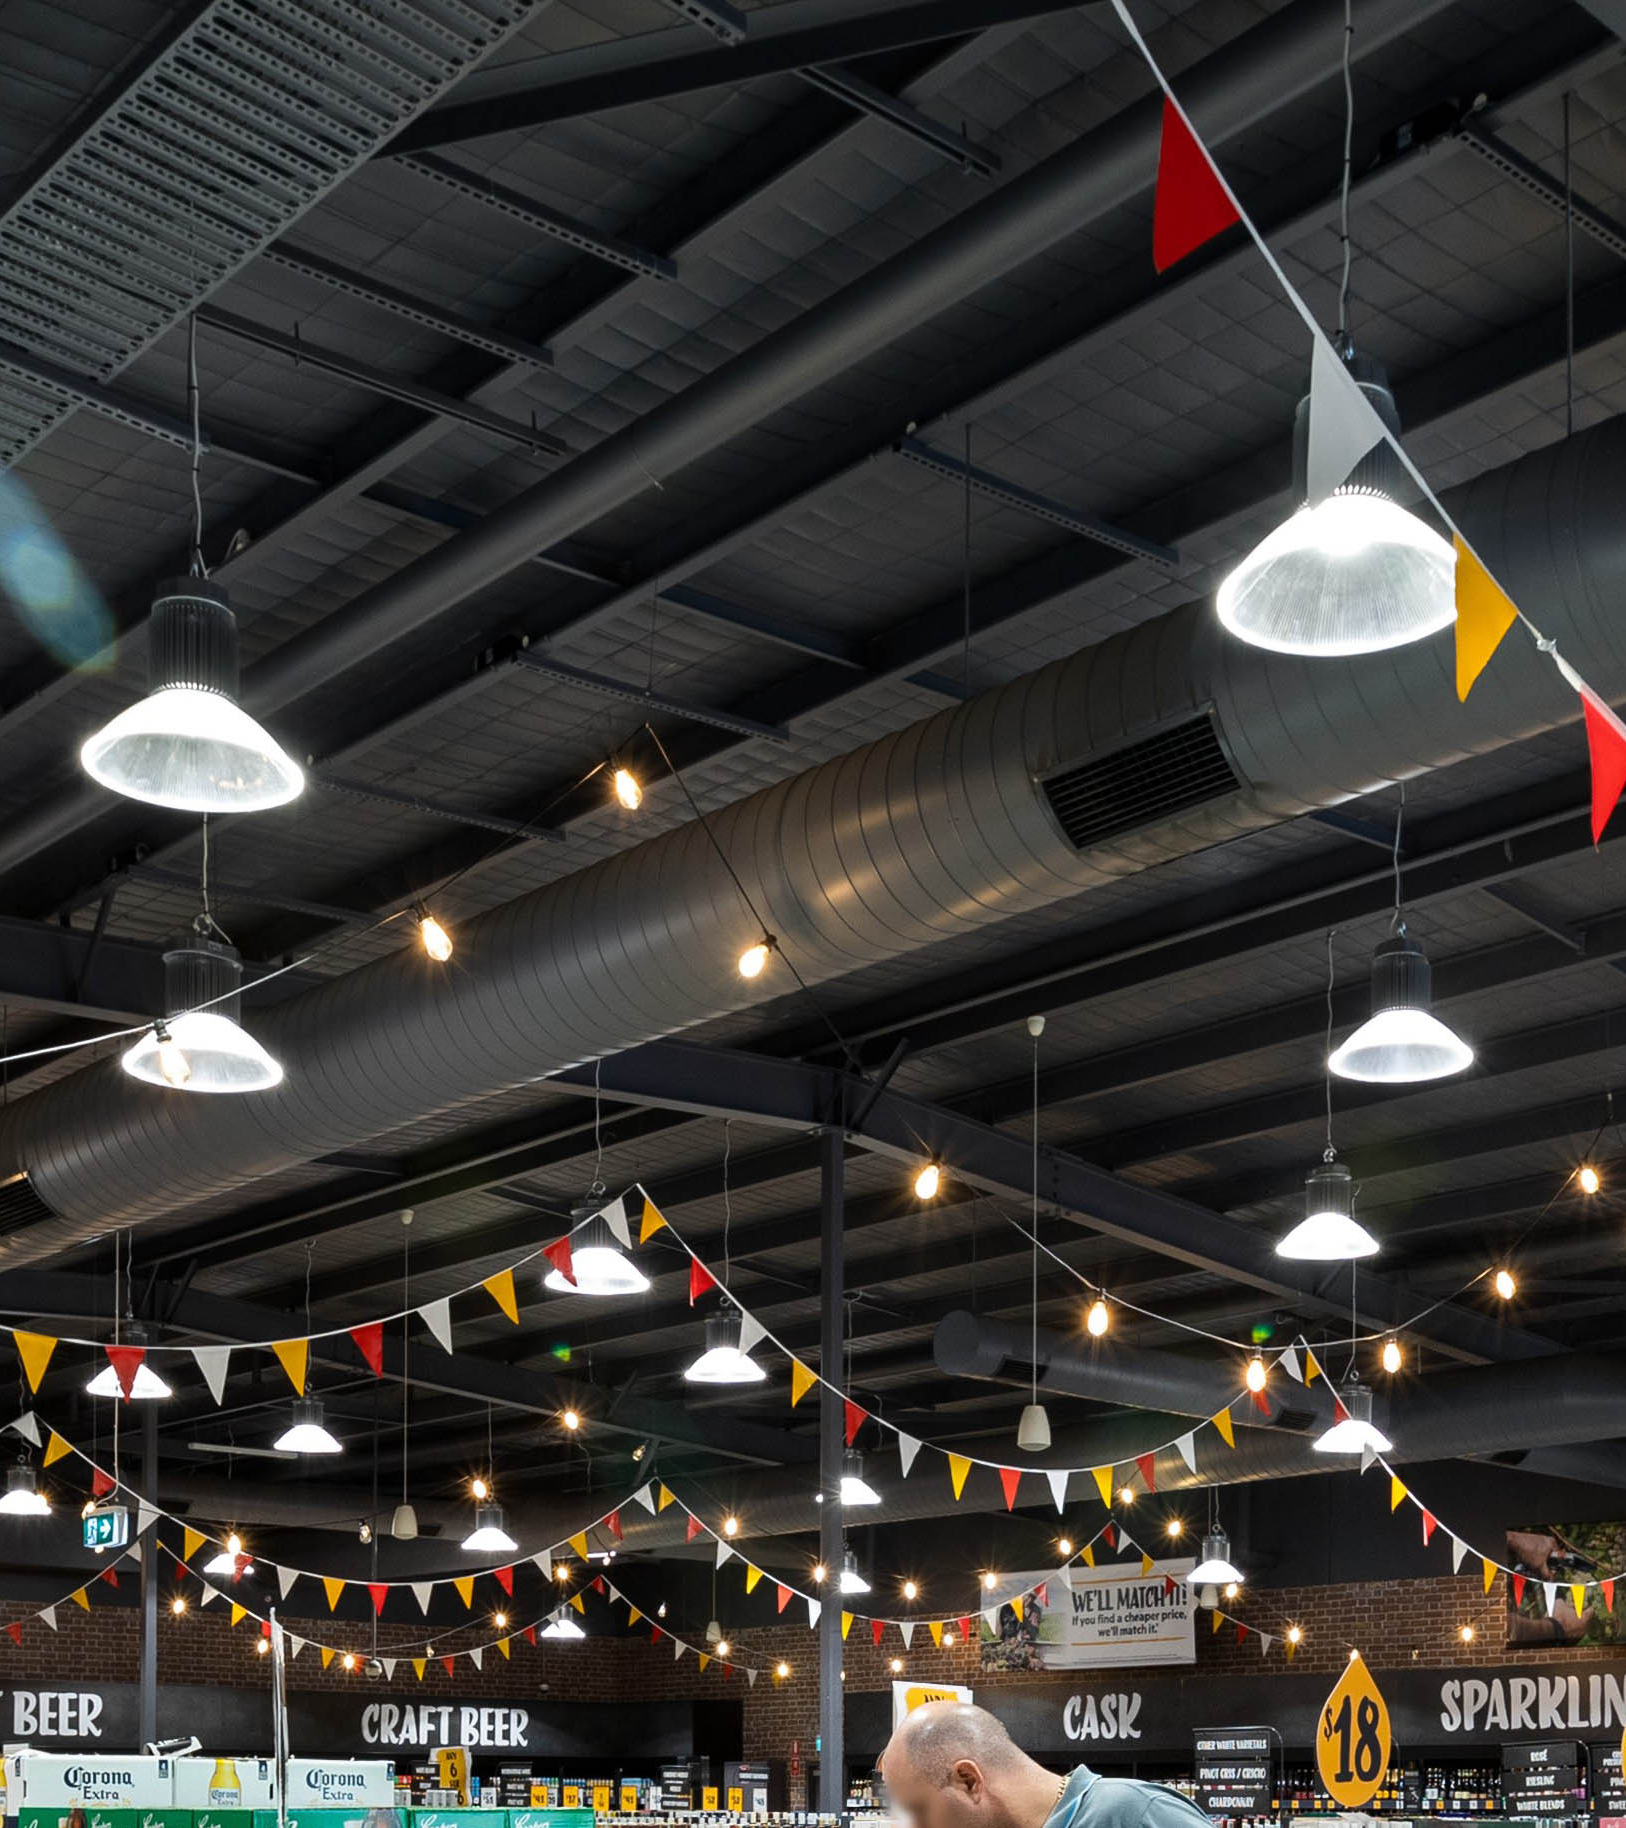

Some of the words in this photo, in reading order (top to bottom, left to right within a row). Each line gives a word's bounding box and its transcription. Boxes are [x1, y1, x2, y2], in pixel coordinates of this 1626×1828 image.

[1072, 1589, 1113, 1612] WE'LL
[1117, 1584, 1165, 1610] MATCH
[1072, 1616, 1078, 1625] If
[1079, 1616, 1095, 1627] you
[1097, 1614, 1114, 1623] find
[1125, 1611, 1159, 1623] cheaper
[1162, 1610, 1187, 1622] price,
[1098, 1626, 1117, 1636] we'll
[1120, 1624, 1147, 1635] match
[14, 1692, 103, 1737] BEER
[361, 1704, 453, 1745] CRAFT
[460, 1707, 528, 1746] BEER
[1063, 1693, 1141, 1740] CASK
[1325, 1695, 1381, 1782] $18
[1200, 1768, 1218, 1779] PINOT
[1220, 1768, 1235, 1779] GRIS
[1526, 1776, 1554, 1786] RIESLING
[1209, 1797, 1254, 1808] CHARDONNAY
